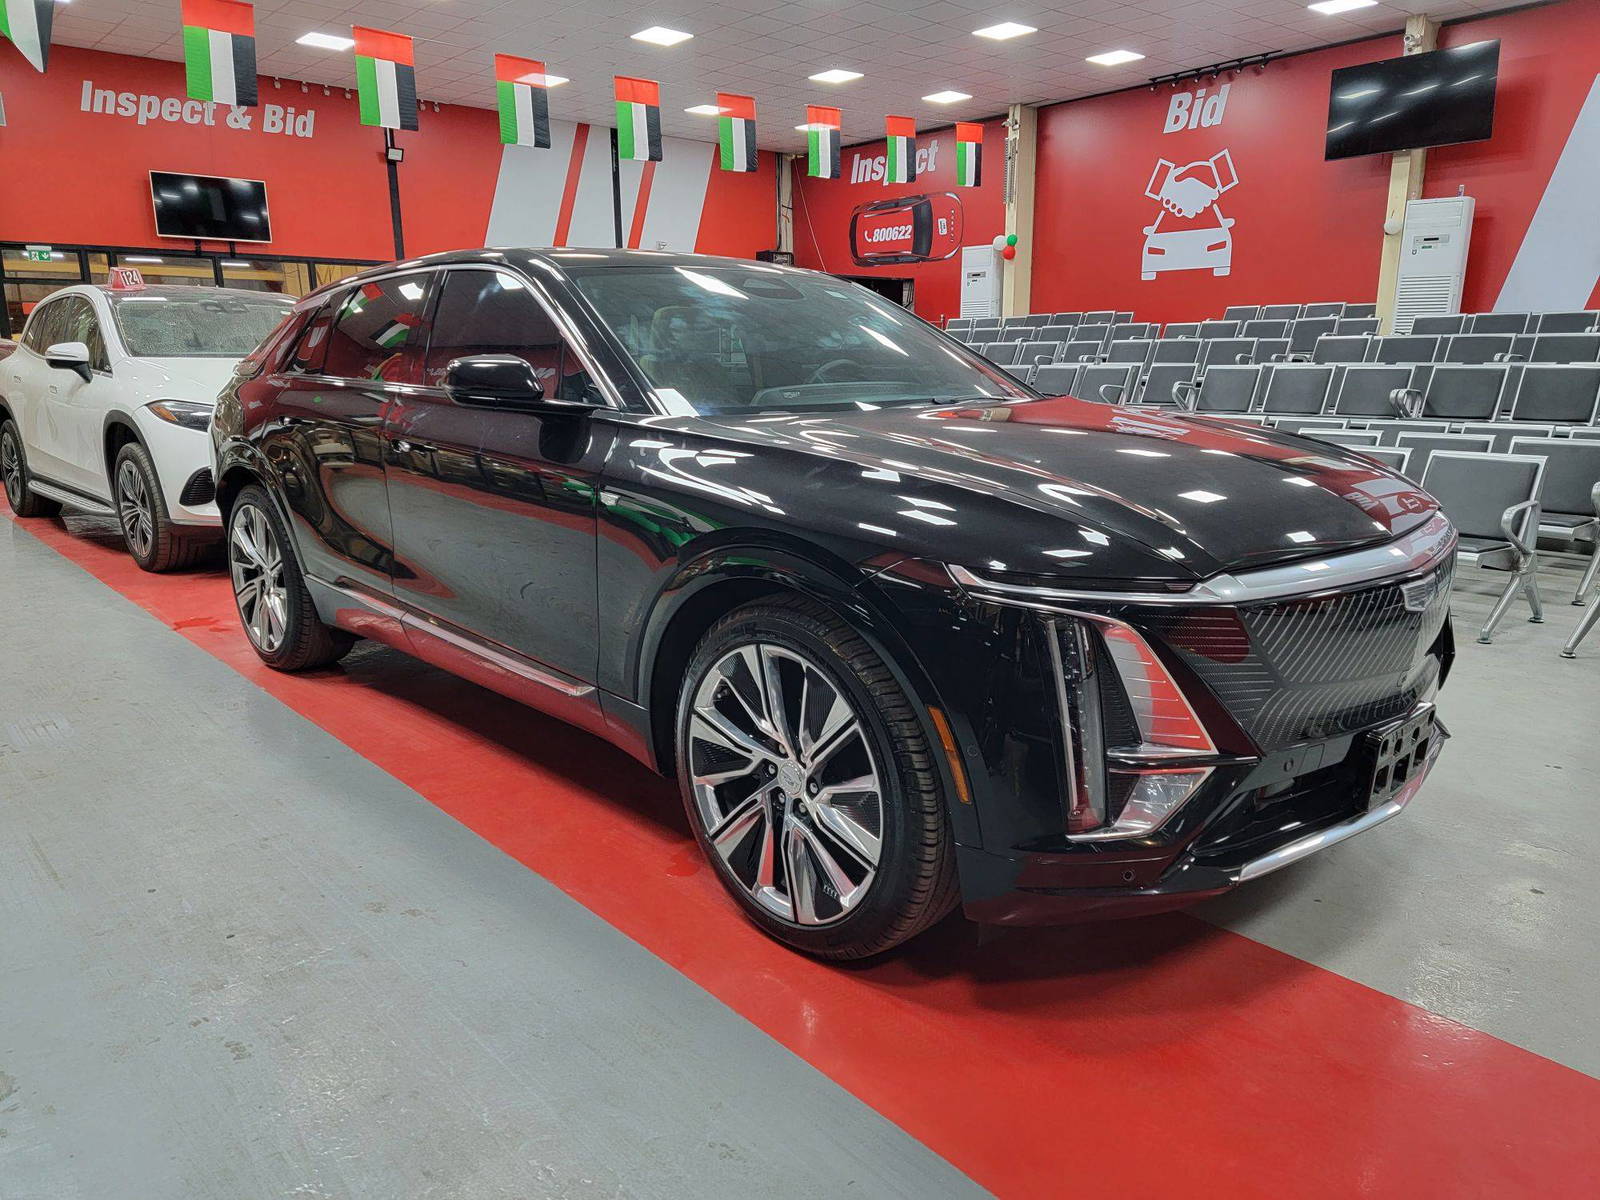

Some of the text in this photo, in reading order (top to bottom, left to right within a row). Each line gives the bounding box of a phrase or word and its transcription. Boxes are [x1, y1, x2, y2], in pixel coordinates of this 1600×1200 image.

[80, 80, 315, 138] Inspect & Bid
[1163, 83, 1231, 134] Bid
[850, 139, 939, 186] Insct
[872, 224, 913, 243] 800622
[122, 270, 140, 286] 124
